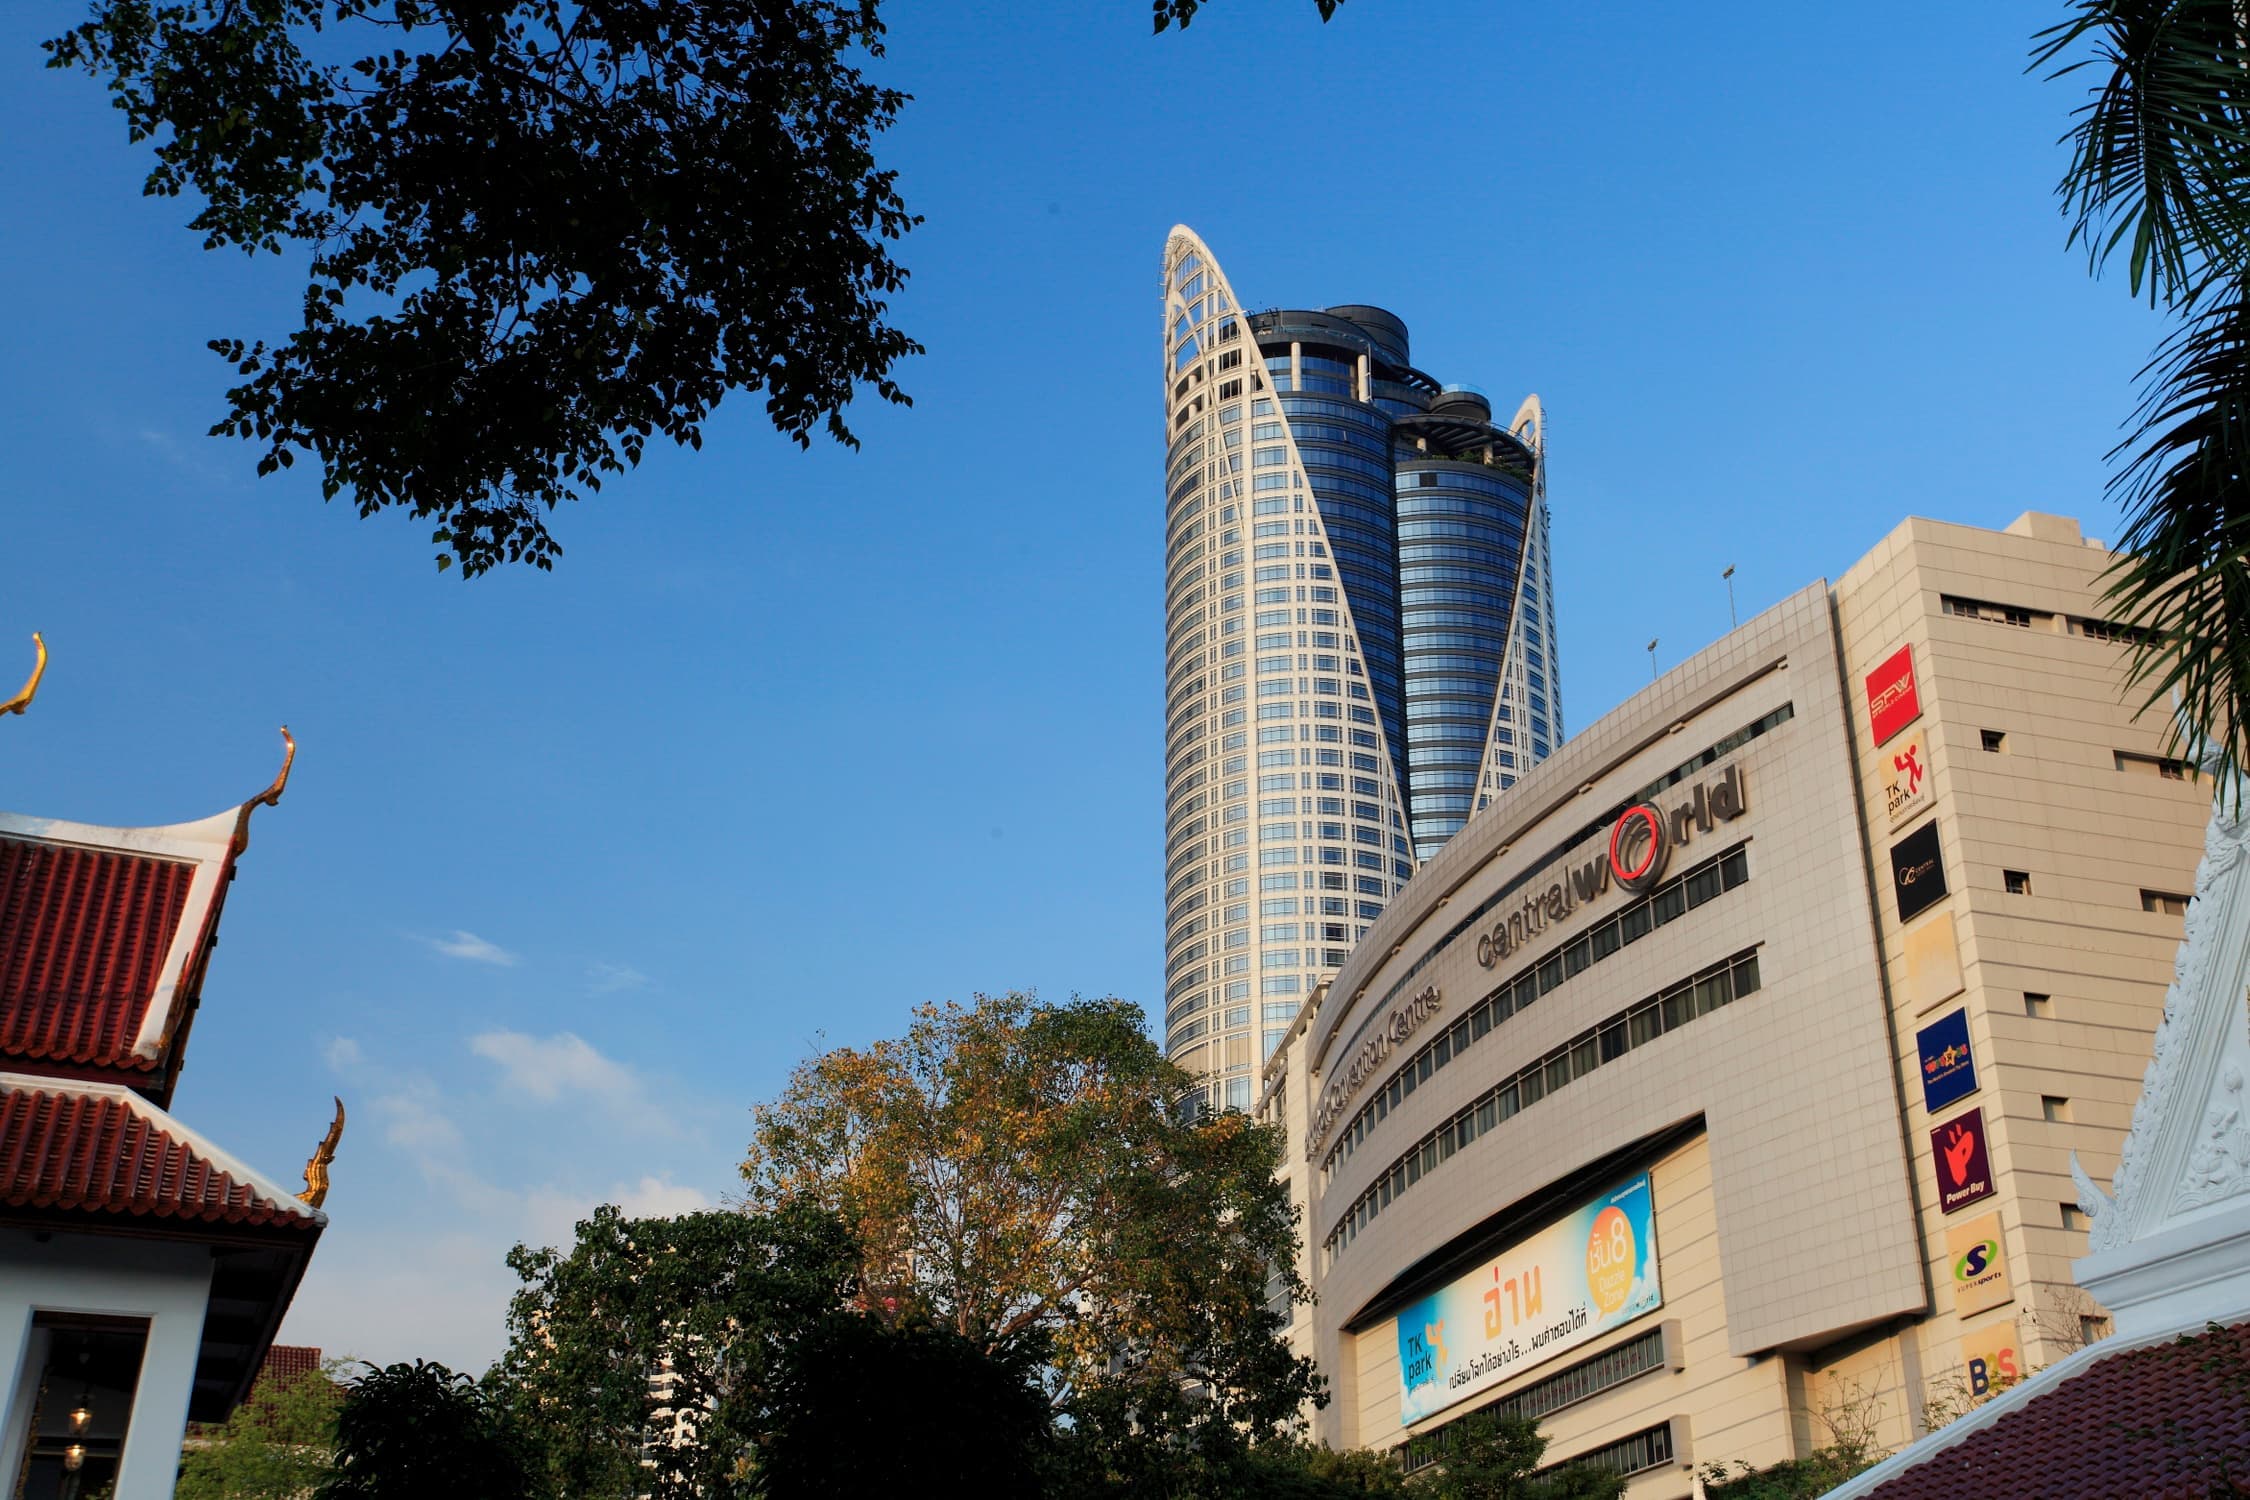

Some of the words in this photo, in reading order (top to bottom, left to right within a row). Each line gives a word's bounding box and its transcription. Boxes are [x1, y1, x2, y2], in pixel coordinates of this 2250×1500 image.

[1885, 780, 1900, 799] TK
[1888, 789, 1911, 816] park
[1389, 985, 1441, 1043] Centre
[1946, 1187, 1970, 1205] Power
[1970, 1181, 1985, 1194] Buy
[1610, 1215, 1627, 1264] 8
[1484, 1265, 1543, 1341] อ่าน
[1408, 1333, 1423, 1359] TK
[1408, 1352, 1433, 1385] park
